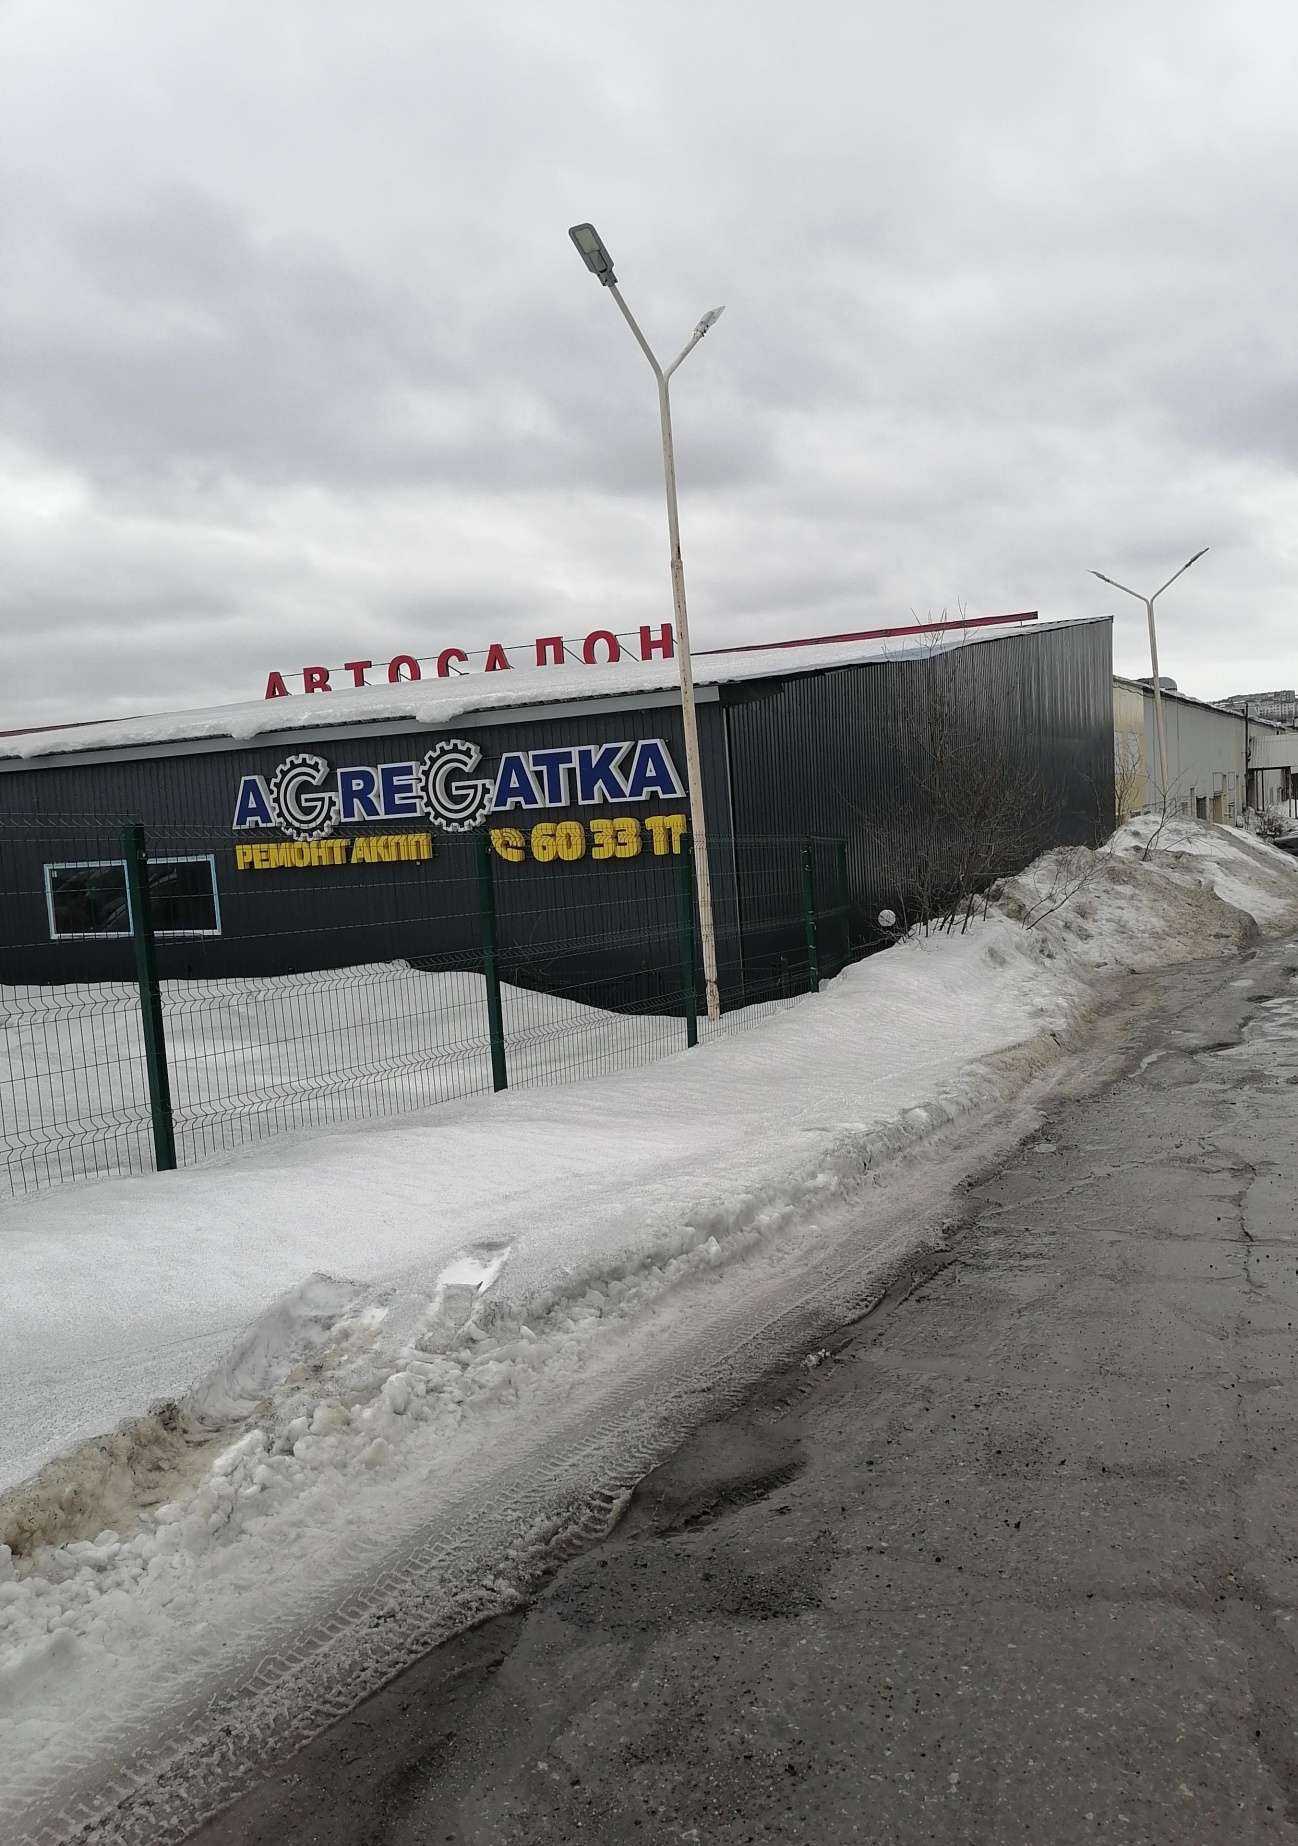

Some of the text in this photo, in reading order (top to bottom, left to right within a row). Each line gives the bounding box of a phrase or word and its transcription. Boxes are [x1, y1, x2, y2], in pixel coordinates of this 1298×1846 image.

[232, 739, 688, 841] AGREGATKA
[235, 833, 432, 870] РЕМОНТ АКПП
[531, 821, 585, 862] 60
[590, 817, 642, 859] 33
